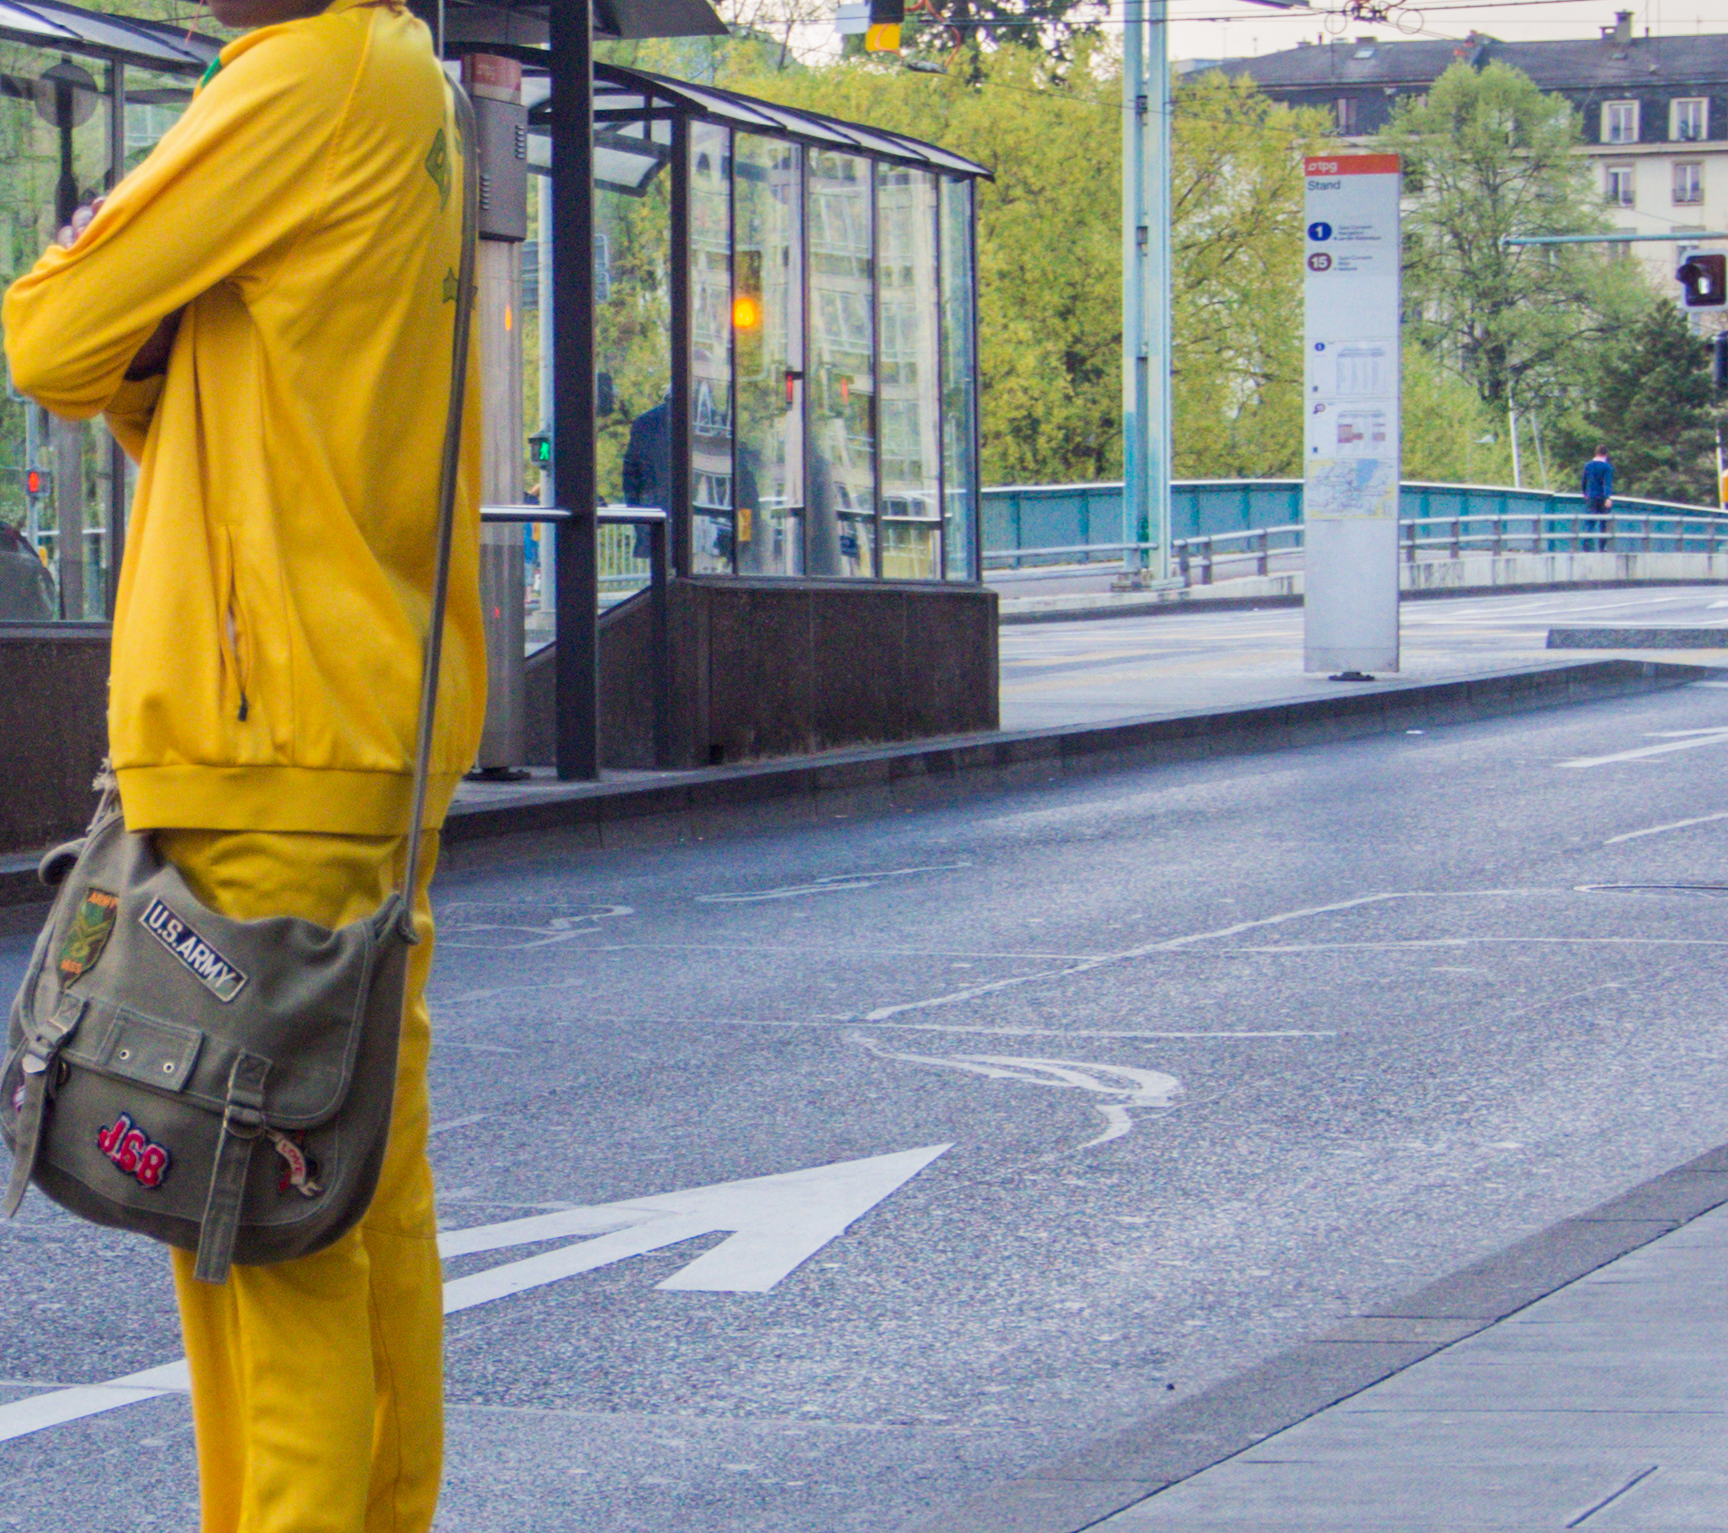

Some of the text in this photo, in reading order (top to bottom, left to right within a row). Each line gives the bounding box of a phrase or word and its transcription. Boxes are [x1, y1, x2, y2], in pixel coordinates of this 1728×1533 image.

[1307, 179, 1341, 191] Stand
[1315, 225, 1324, 239] 1
[1310, 255, 1329, 269] 15
[280, 1141, 304, 1178] LOVE
